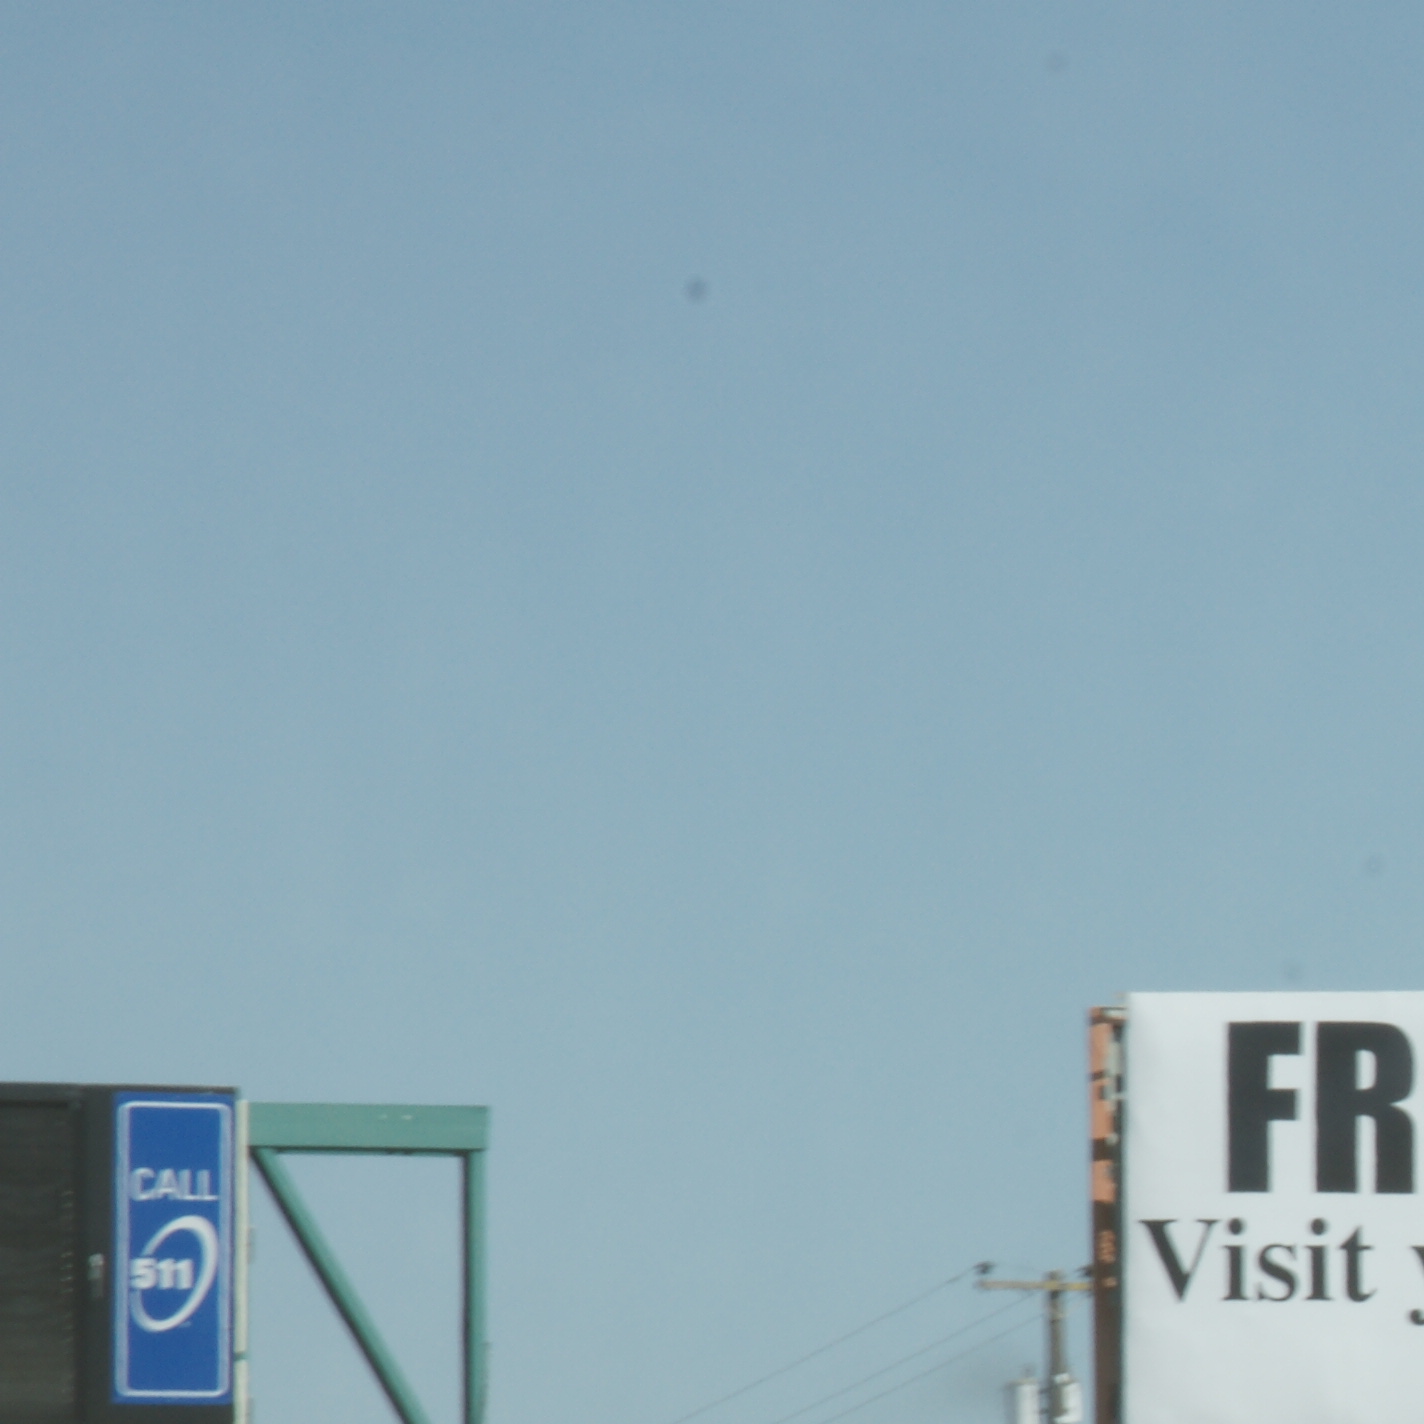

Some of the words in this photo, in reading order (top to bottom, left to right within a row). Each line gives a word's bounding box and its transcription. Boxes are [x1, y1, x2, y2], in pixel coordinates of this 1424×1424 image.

[130, 1167, 218, 1201] CALL
[129, 1257, 195, 1291] 511
[1139, 1217, 1375, 1303] Visit
